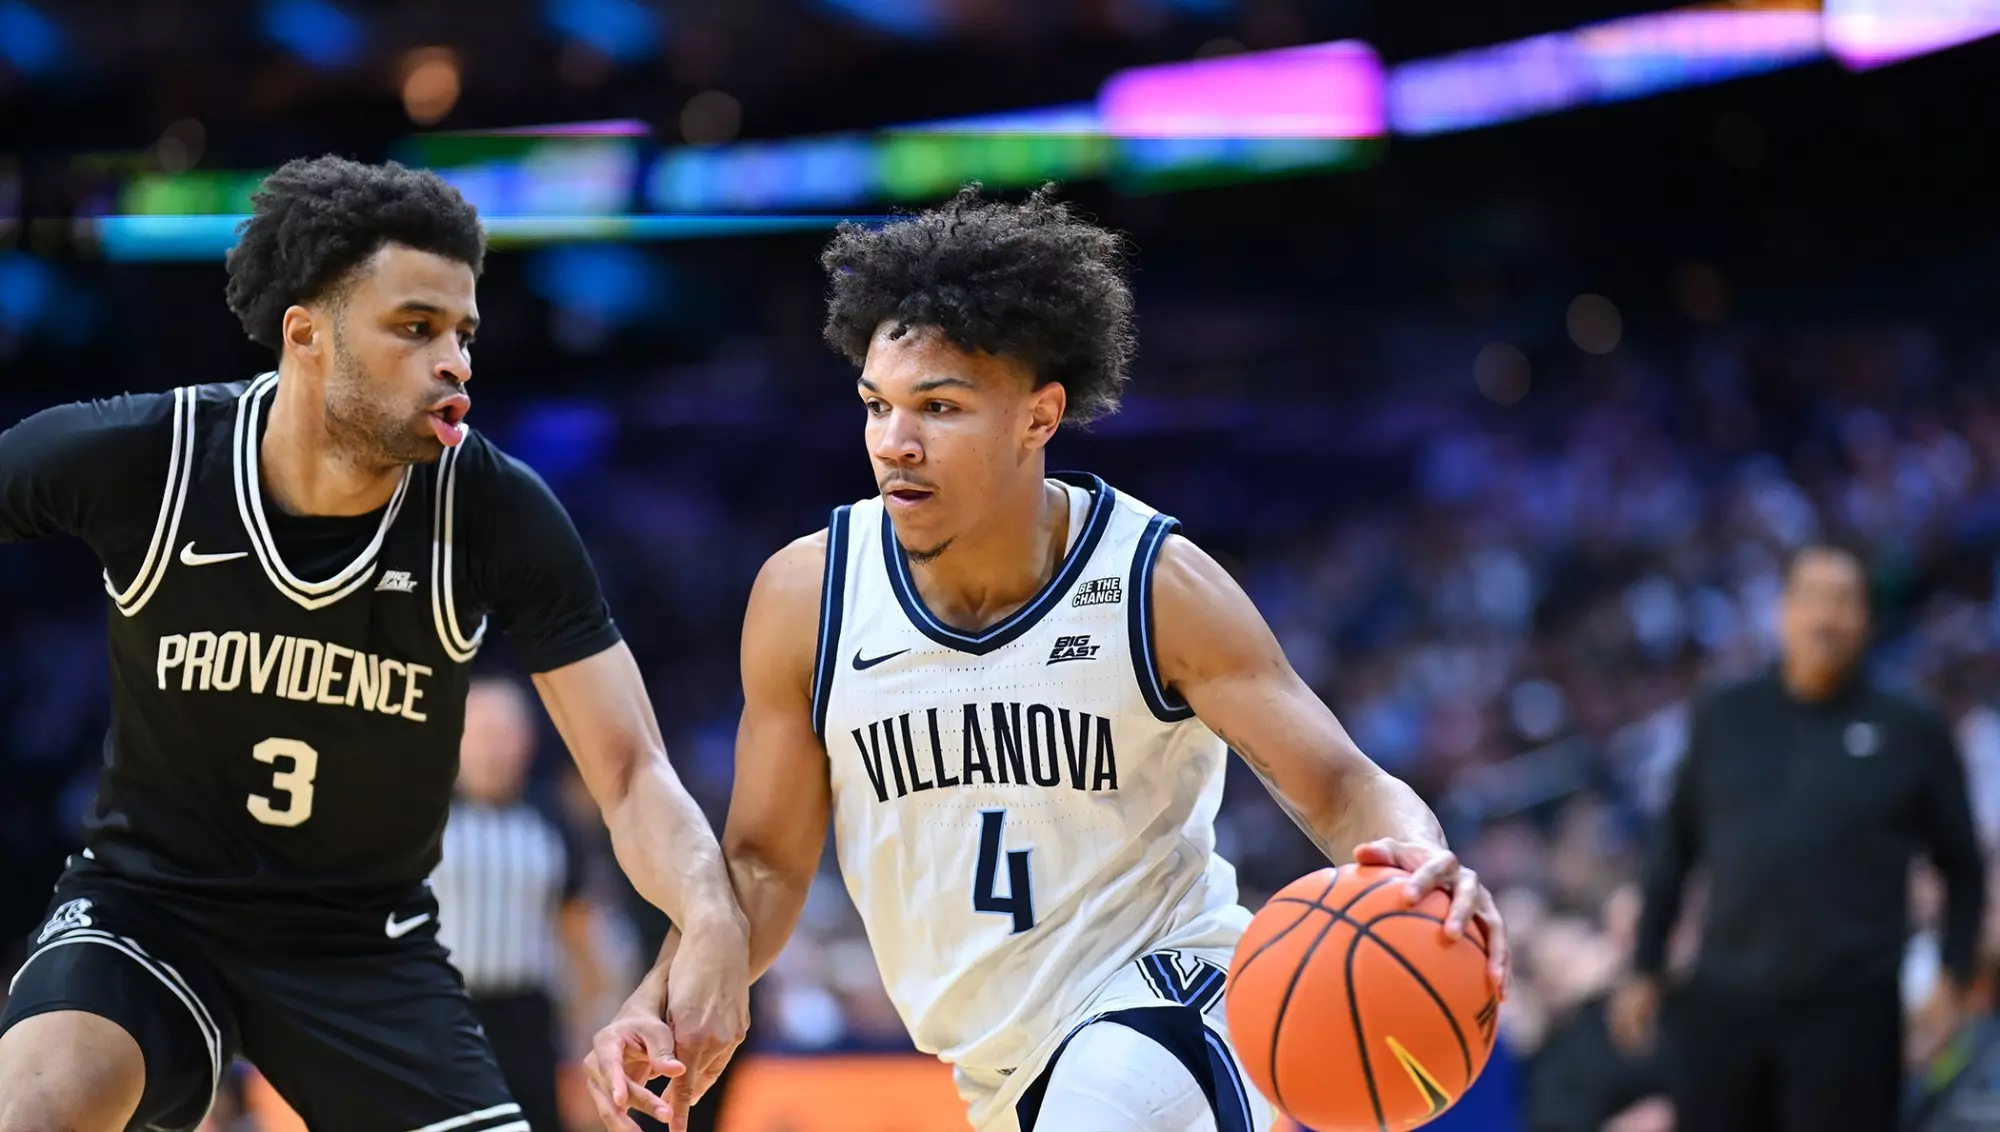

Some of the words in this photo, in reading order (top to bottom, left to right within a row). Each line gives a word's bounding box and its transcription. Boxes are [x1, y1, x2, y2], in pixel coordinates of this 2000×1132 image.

[1073, 589, 1121, 607] CHANGE
[1078, 581, 1094, 595] BE
[1096, 578, 1120, 591] THE
[1049, 645, 1100, 659] EAST
[1054, 635, 1091, 648] BIG
[157, 631, 432, 722] PROVIDENCE
[851, 702, 1118, 802] VILLANOVA
[246, 737, 318, 828] 3
[972, 808, 1036, 935] 4
